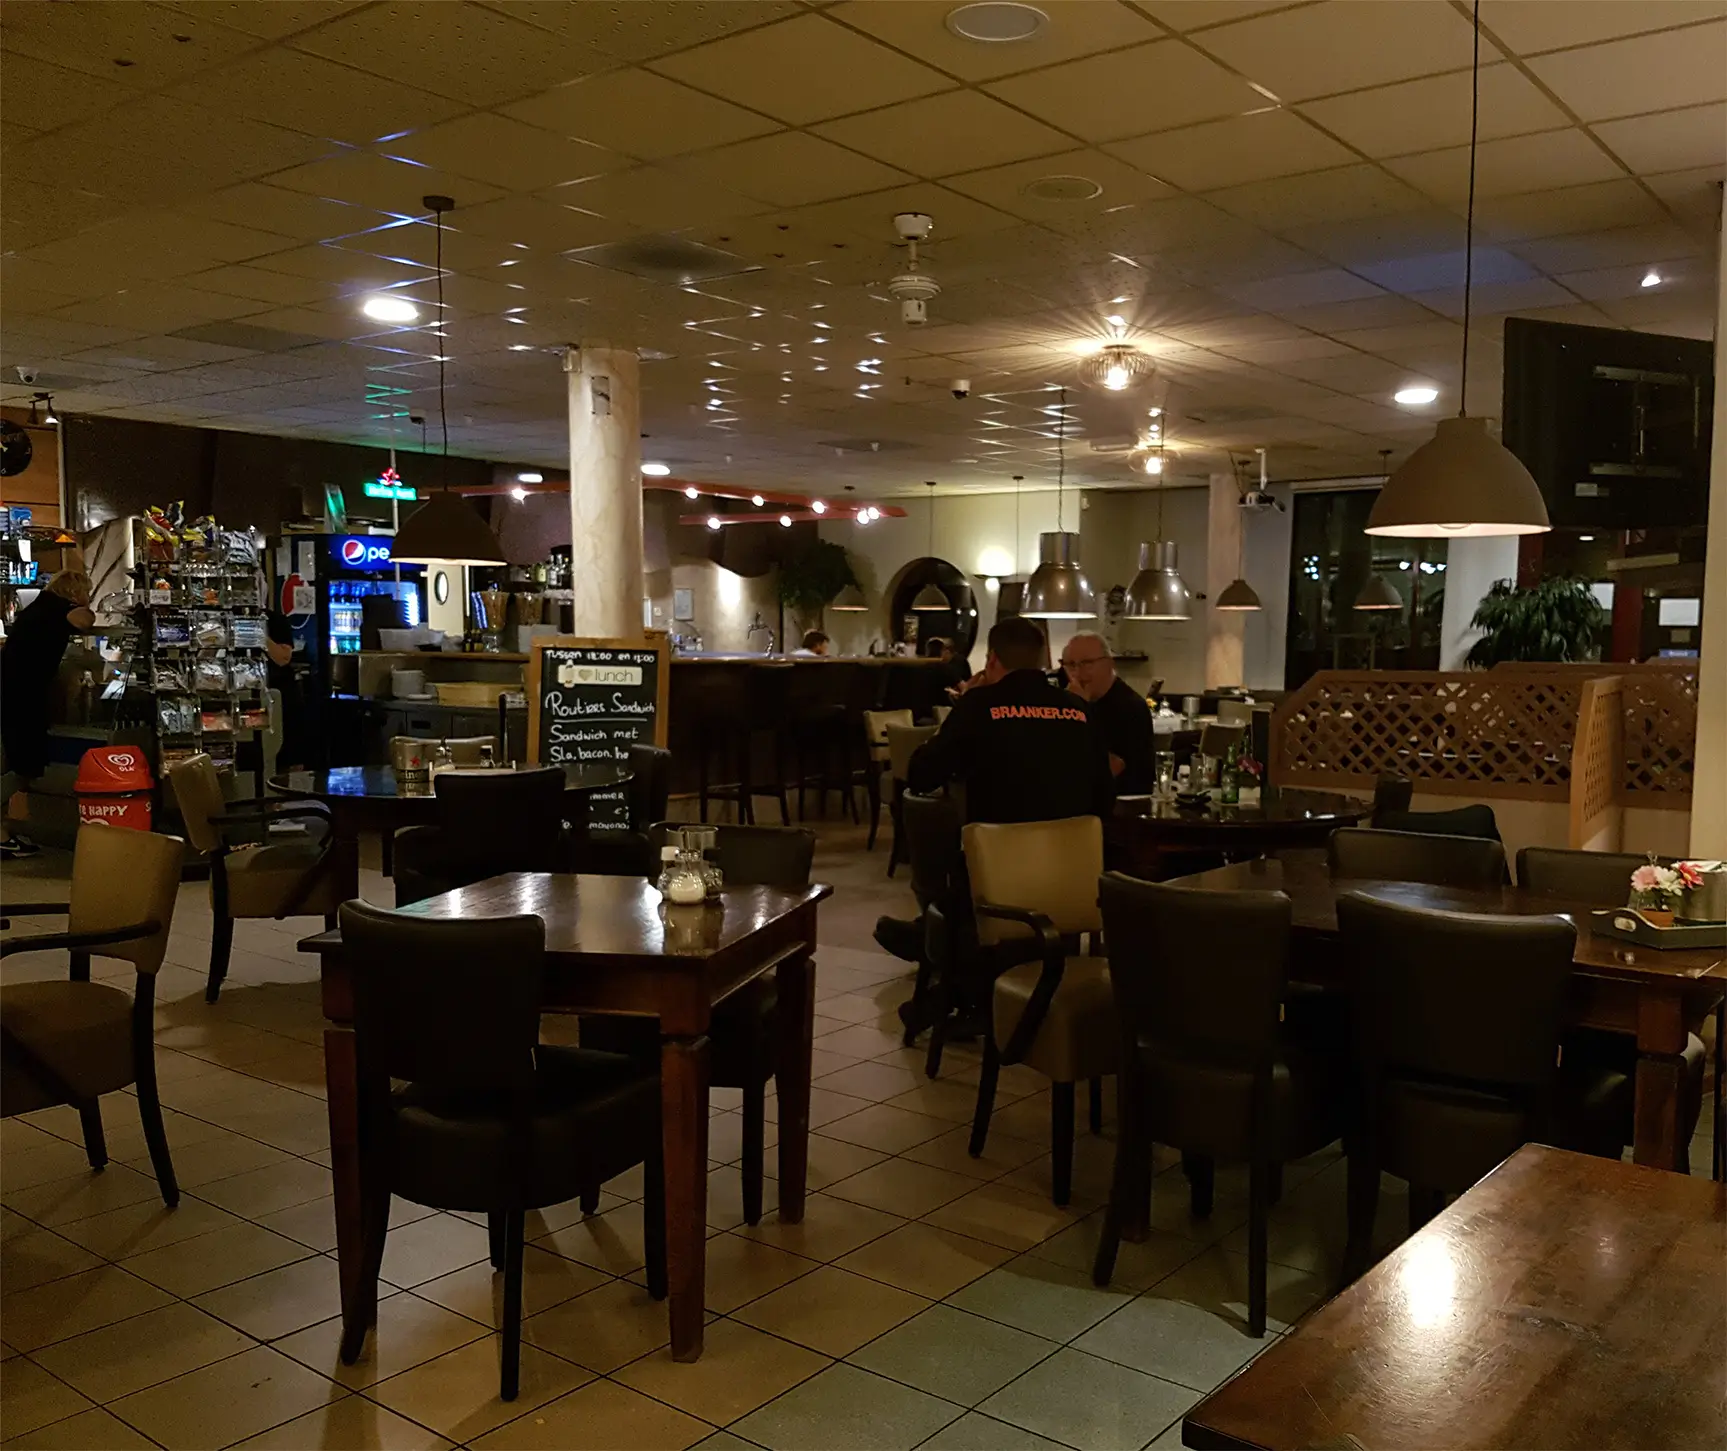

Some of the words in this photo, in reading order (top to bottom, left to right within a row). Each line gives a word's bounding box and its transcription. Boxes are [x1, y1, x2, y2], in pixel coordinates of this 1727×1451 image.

[367, 546, 392, 563] pe
[618, 653, 631, 661] en
[595, 669, 633, 682] lunch
[610, 692, 655, 714] Sandwich
[989, 705, 1088, 724] BRAANKER.COM
[548, 724, 607, 743] Sandwich
[613, 727, 639, 739] met
